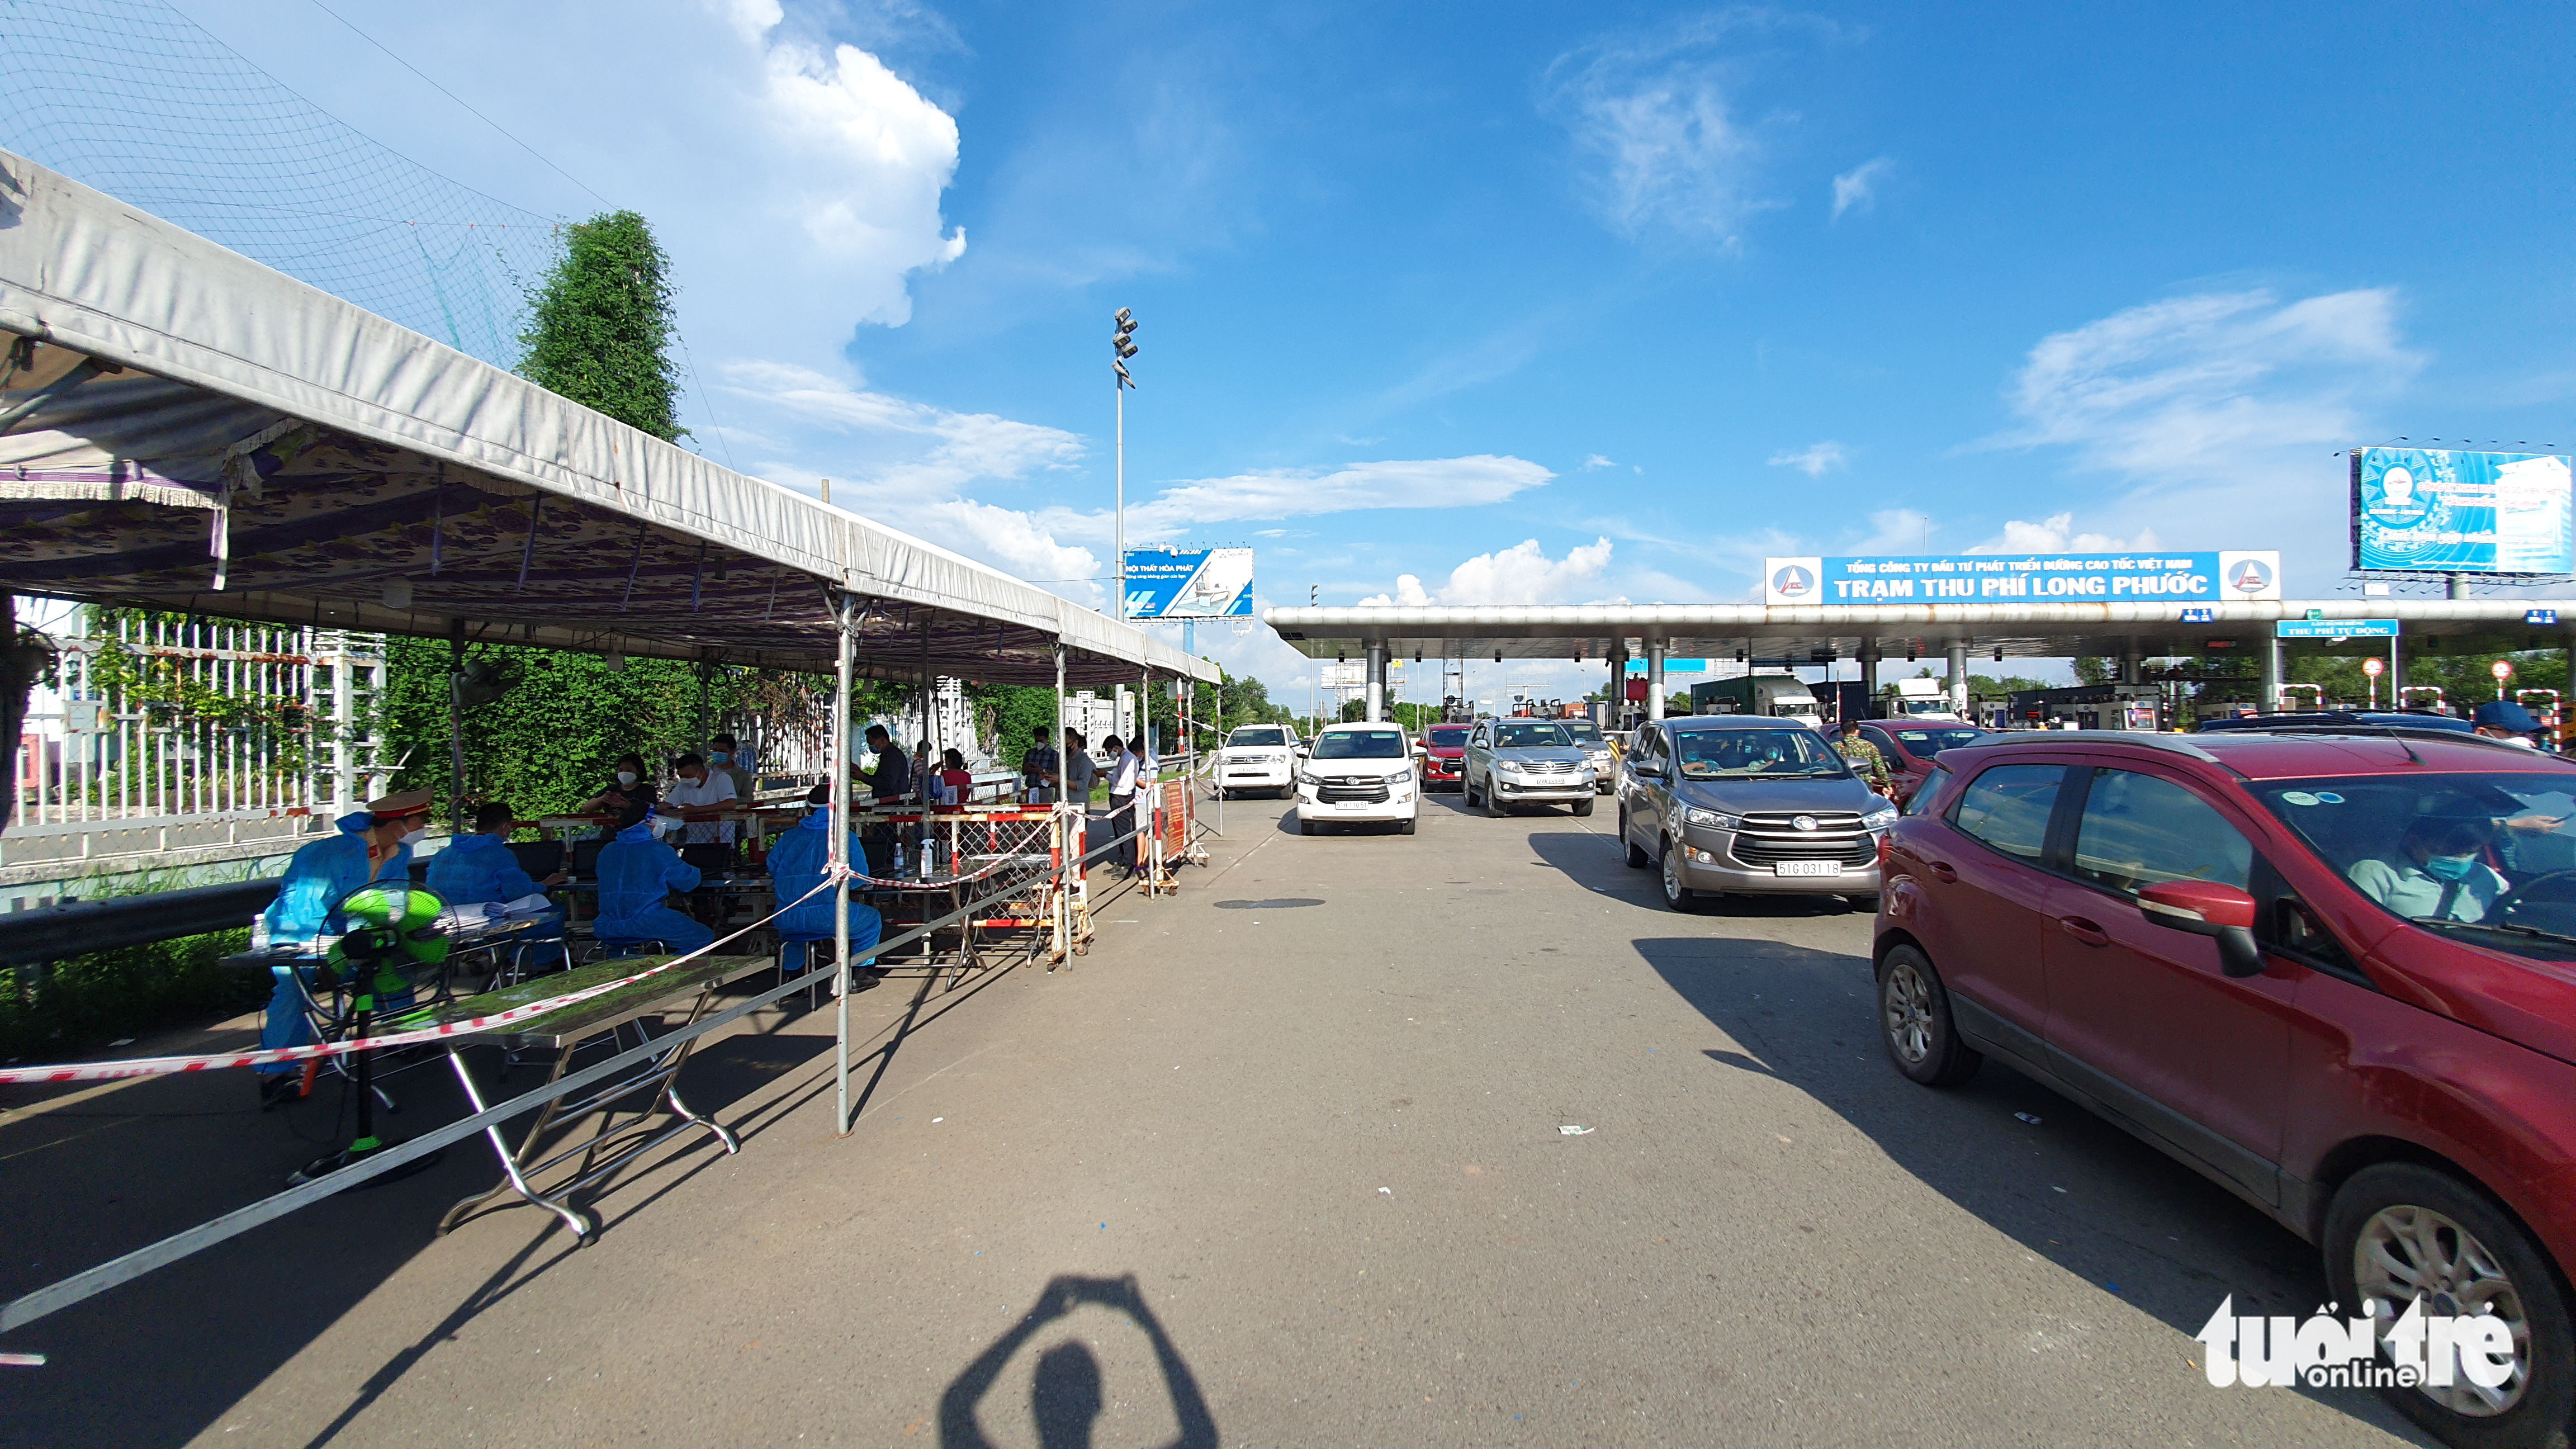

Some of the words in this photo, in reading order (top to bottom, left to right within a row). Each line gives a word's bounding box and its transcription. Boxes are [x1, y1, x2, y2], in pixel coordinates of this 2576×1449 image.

[1176, 564, 1194, 572] PHÁT
[1914, 562, 1930, 572] TY
[1976, 560, 2006, 572] PHÁT
[2085, 560, 2109, 570] CAO
[1834, 579, 1913, 602] TRẠM
[1921, 578, 1974, 596] THU
[1982, 573, 2030, 596] PHÍ
[2033, 576, 2106, 595] LONG
[2113, 571, 2208, 595] PHƯỚC
[2314, 626, 2334, 635] PHÍ
